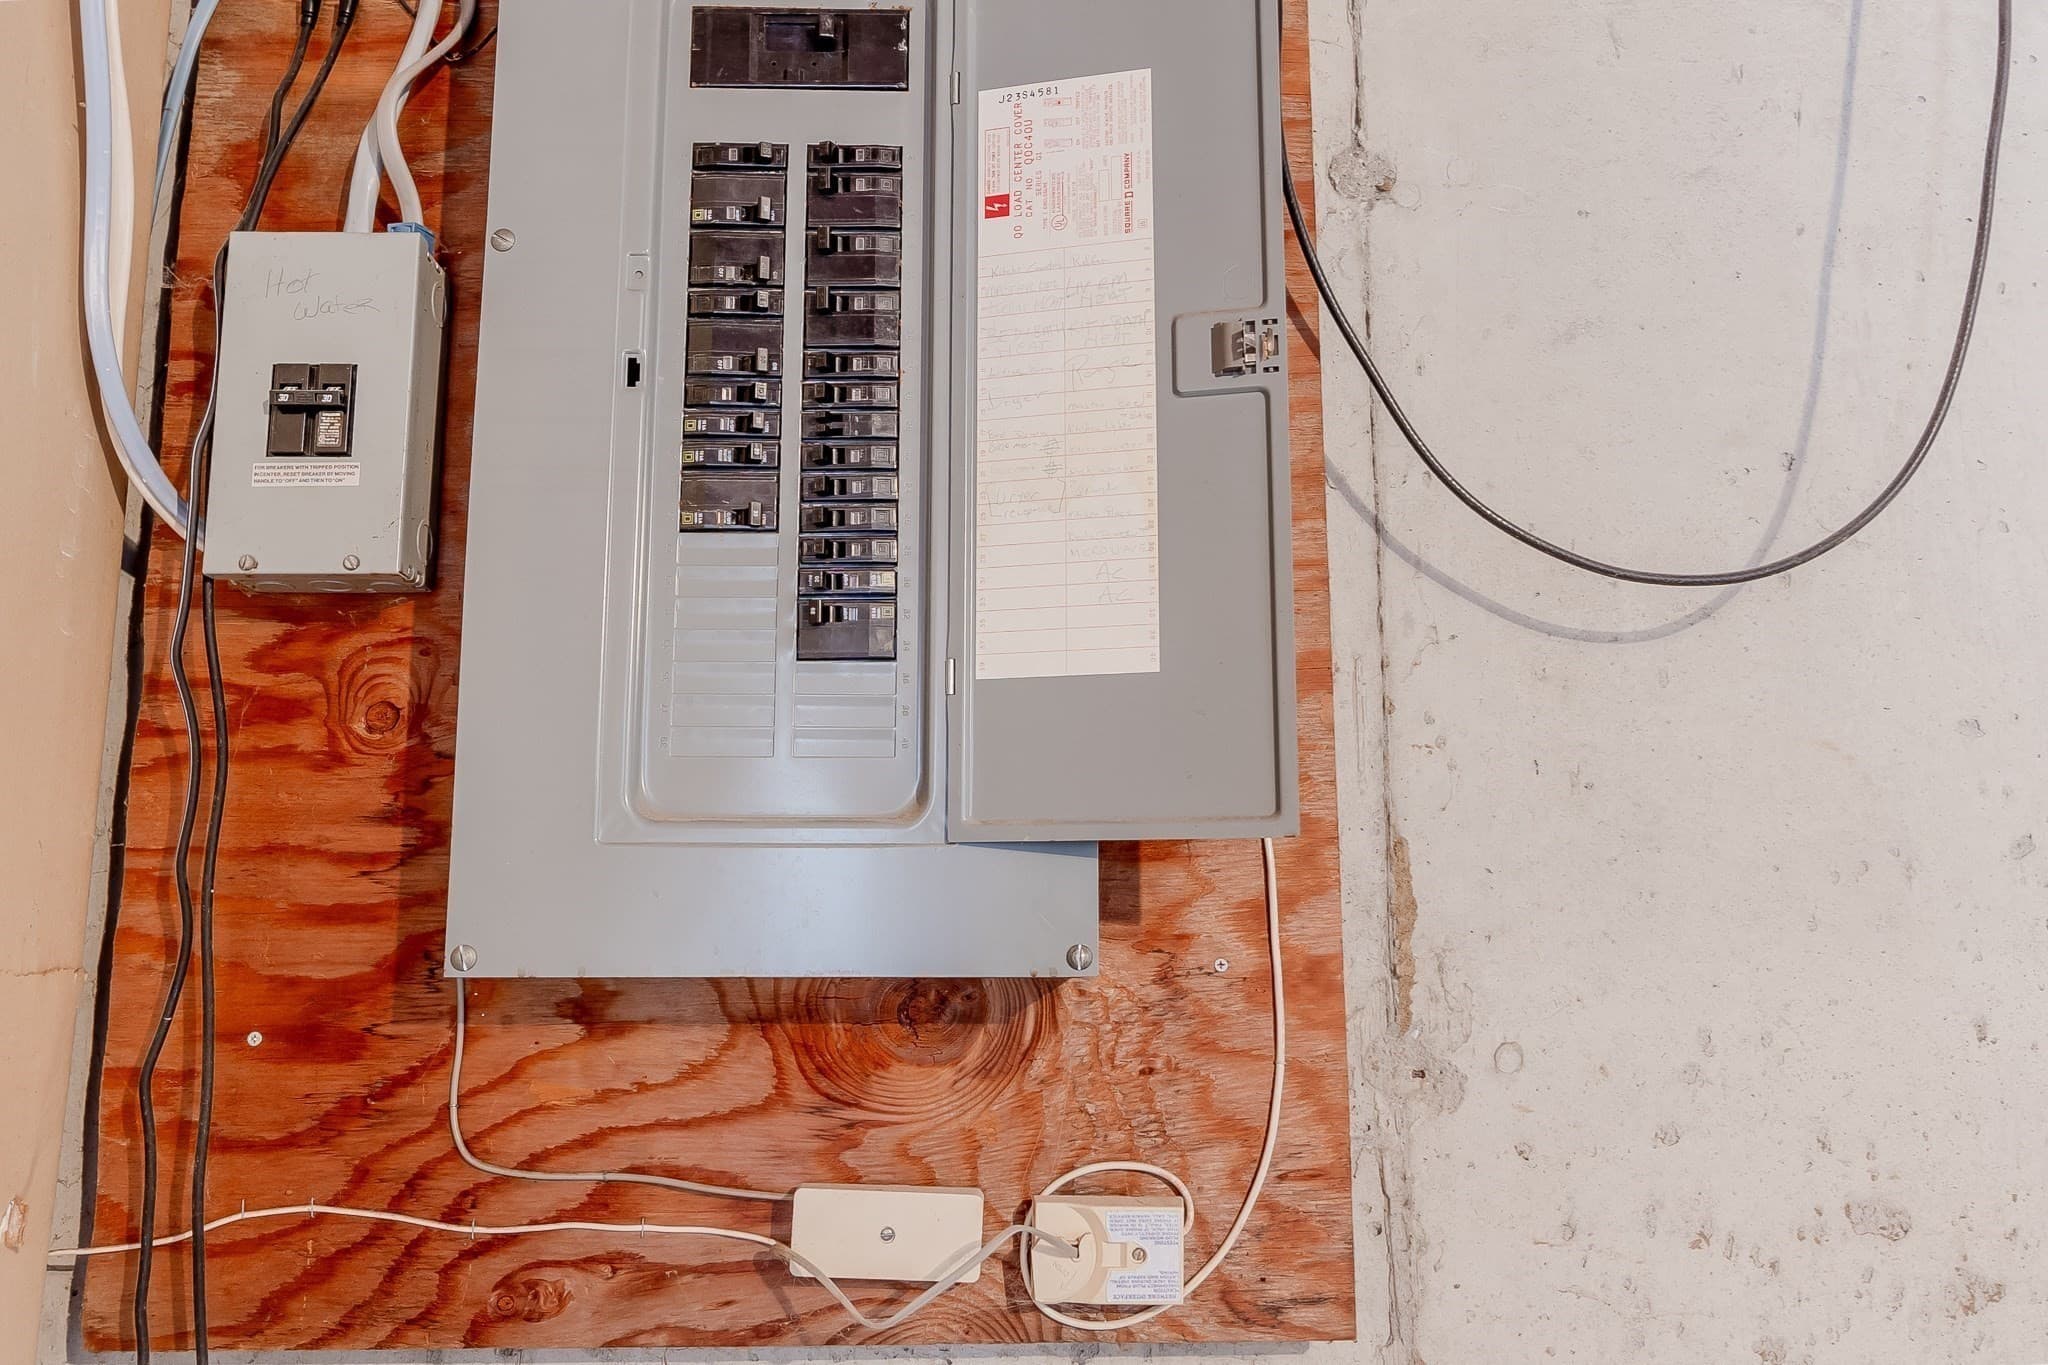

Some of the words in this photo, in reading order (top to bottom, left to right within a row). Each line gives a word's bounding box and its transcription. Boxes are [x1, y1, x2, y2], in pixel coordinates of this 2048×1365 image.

[1014, 103, 1022, 135] COVER
[1014, 143, 1022, 182] CENTER
[1014, 190, 1022, 217] LOAD
[264, 266, 320, 298] Hot
[294, 296, 381, 321] Water
[278, 394, 289, 402] 30
[321, 394, 332, 402] 30
[903, 608, 911, 620] 32
